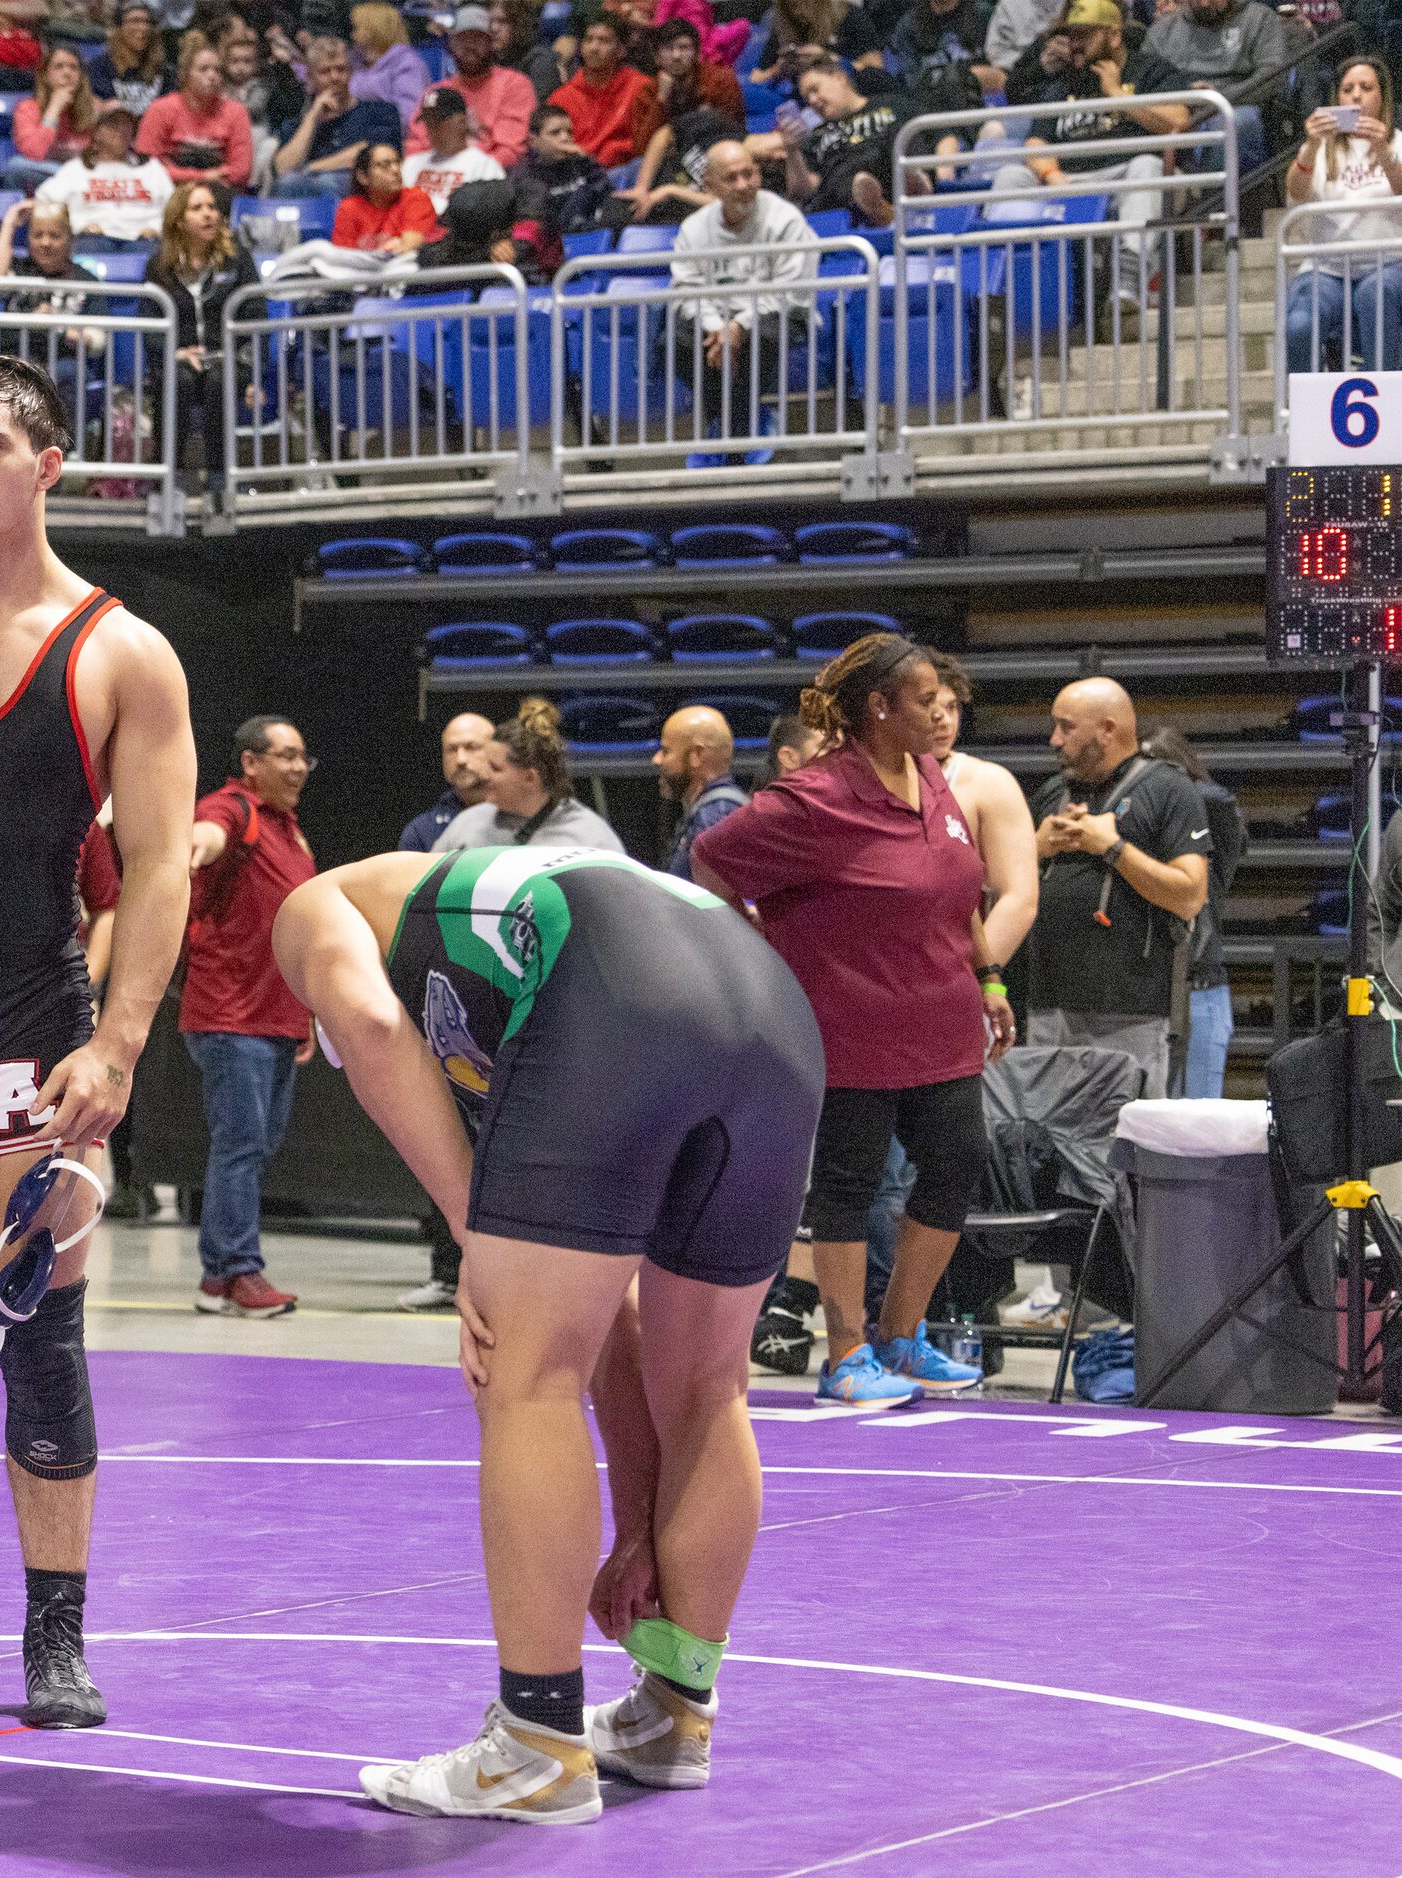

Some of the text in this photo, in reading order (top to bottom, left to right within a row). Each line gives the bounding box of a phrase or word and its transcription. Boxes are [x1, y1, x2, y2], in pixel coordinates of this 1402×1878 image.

[1331, 377, 1380, 448] 6
[1285, 471, 1314, 523] 2
[1300, 528, 1348, 581] 10
[29, 1450, 58, 1462] SHOCK
